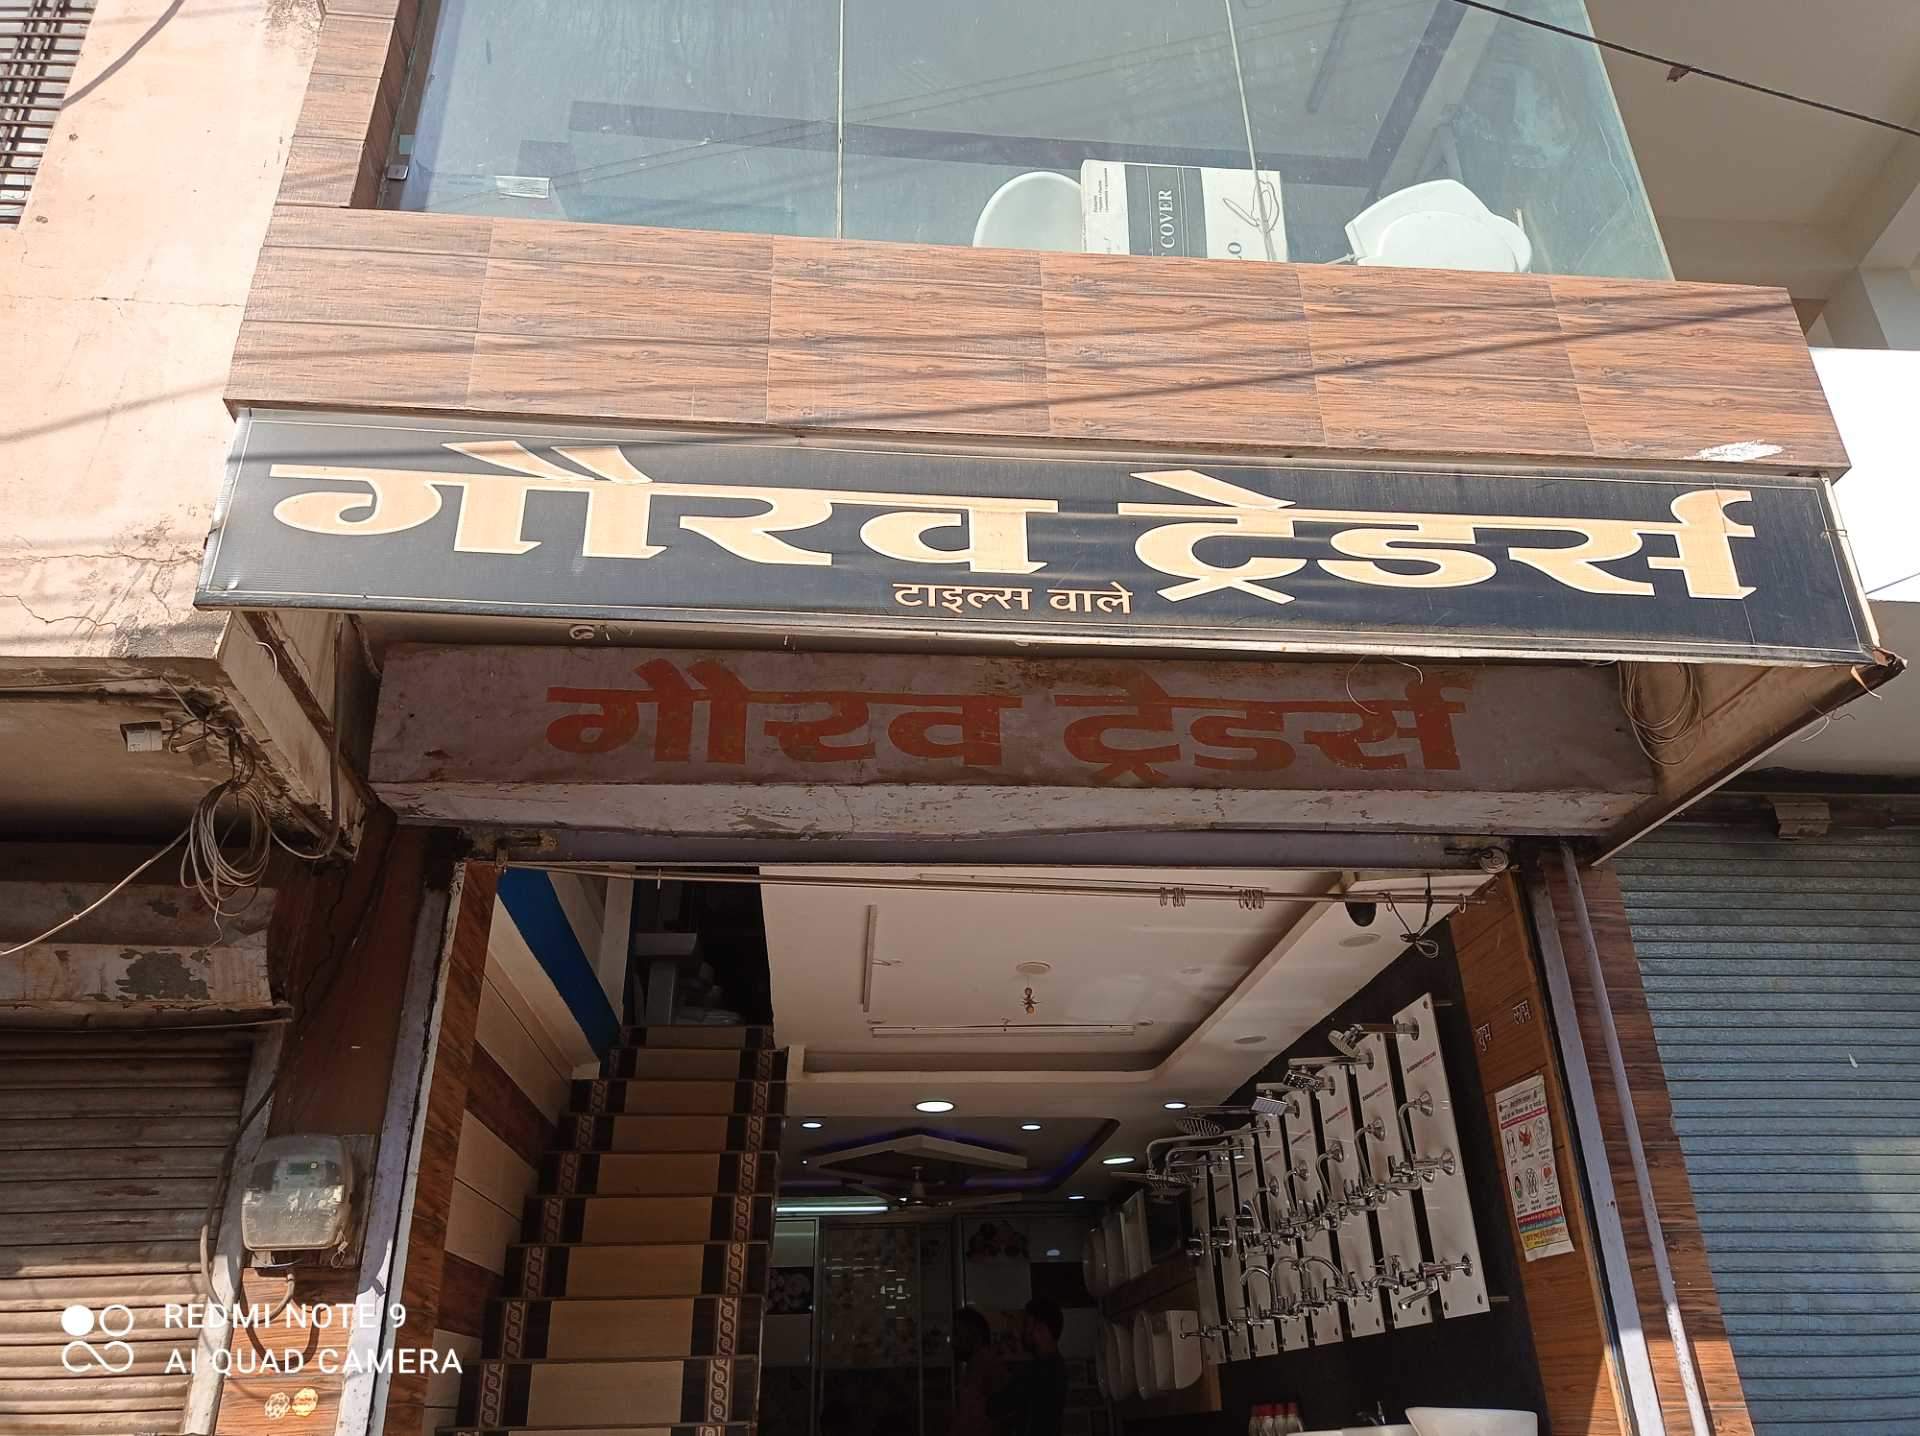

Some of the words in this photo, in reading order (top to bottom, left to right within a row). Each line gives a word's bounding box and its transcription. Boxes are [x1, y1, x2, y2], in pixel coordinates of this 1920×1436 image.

[1158, 190, 1175, 249] COVER
[270, 441, 1059, 574] गौरव
[1117, 469, 1757, 604] ट्रेडर्स
[892, 583, 1033, 613] टाइल्स
[1047, 581, 1134, 615] वाले
[546, 659, 1022, 766] गौरव
[1054, 668, 1473, 784] ट्रेडर्स
